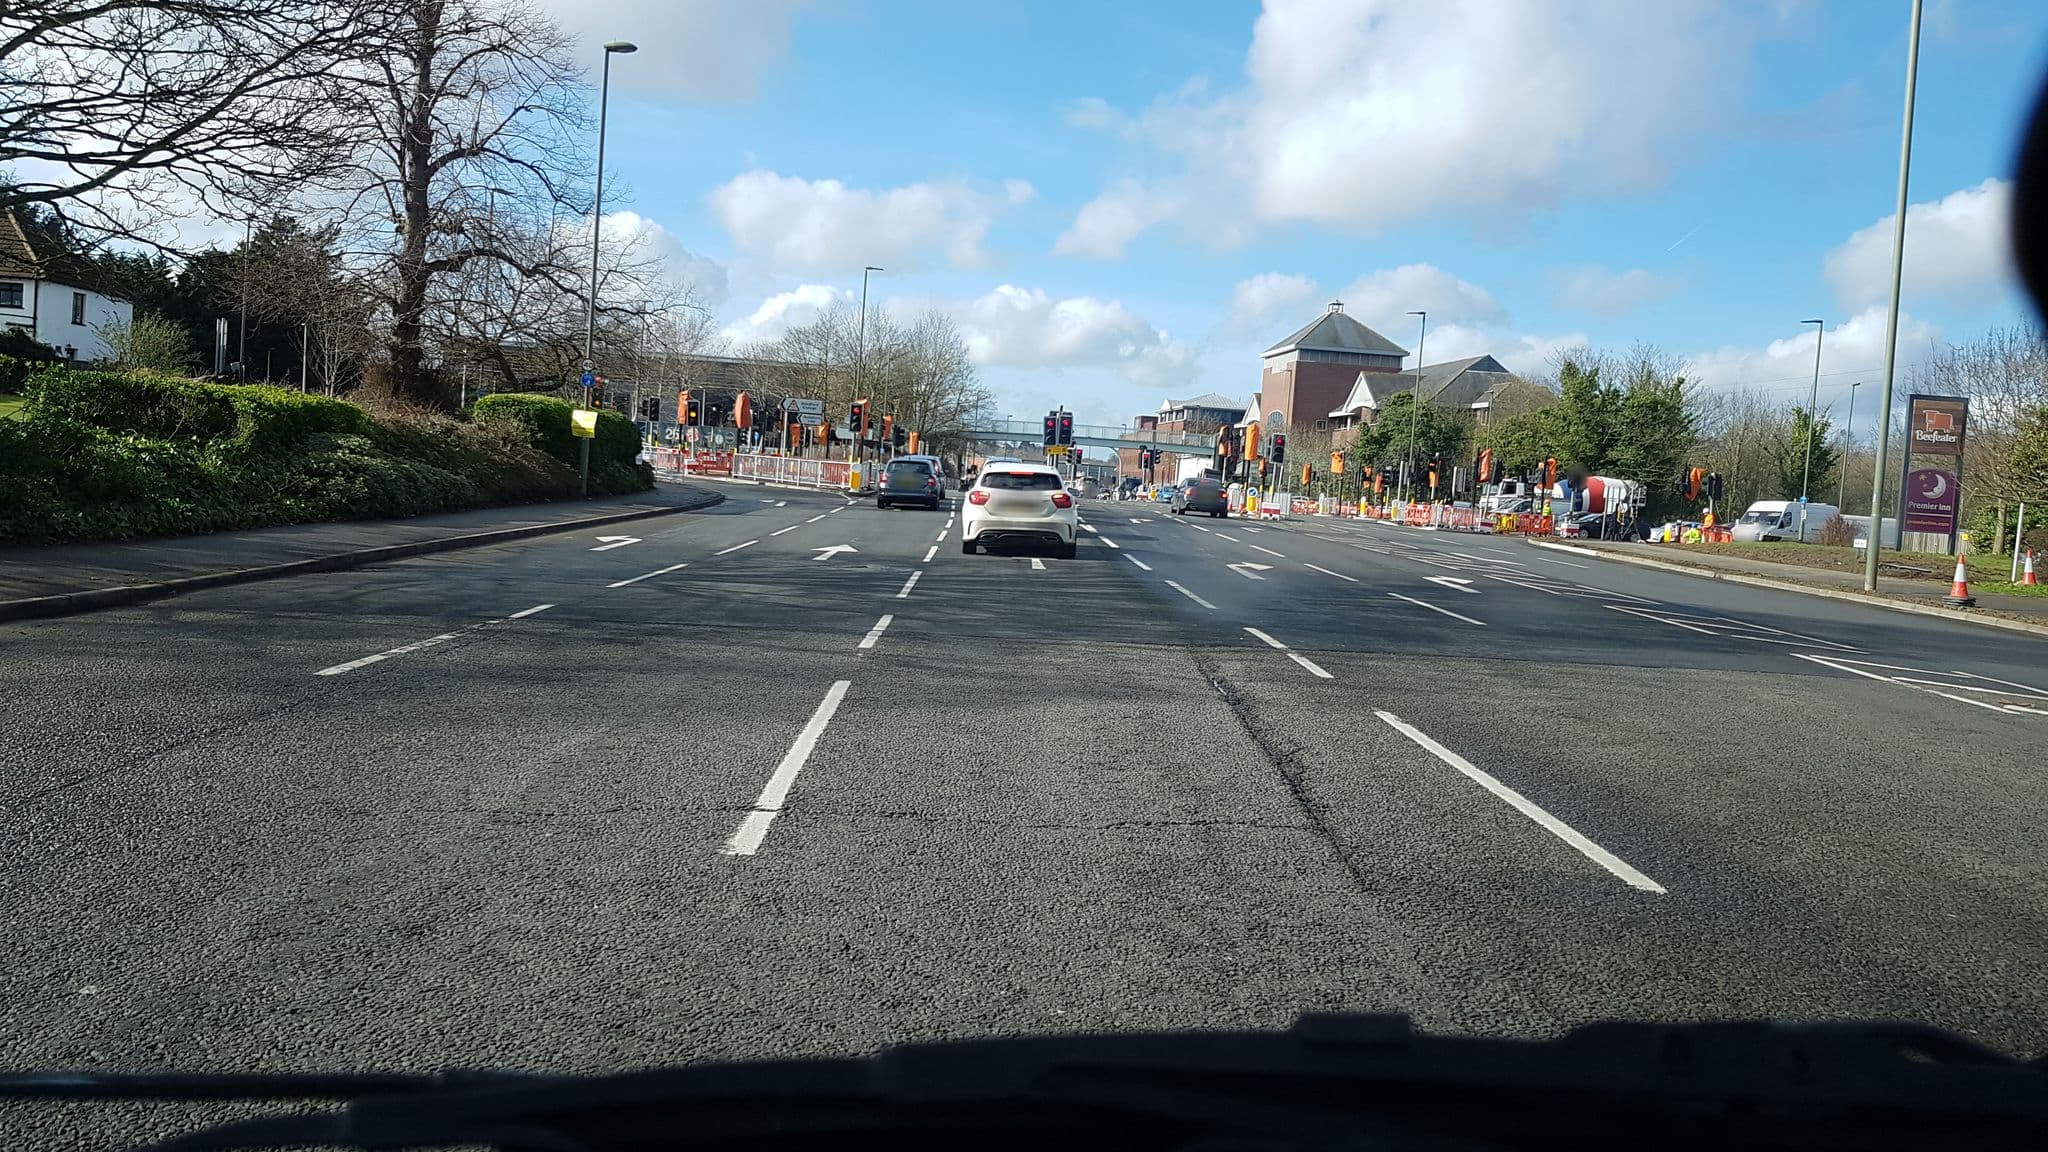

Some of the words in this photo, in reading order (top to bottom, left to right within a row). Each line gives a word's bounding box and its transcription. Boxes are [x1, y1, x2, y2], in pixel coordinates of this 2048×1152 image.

[1916, 430, 1956, 443] Beefeater
[1908, 501, 1938, 510] Premier
[1939, 503, 1951, 511] Inn
